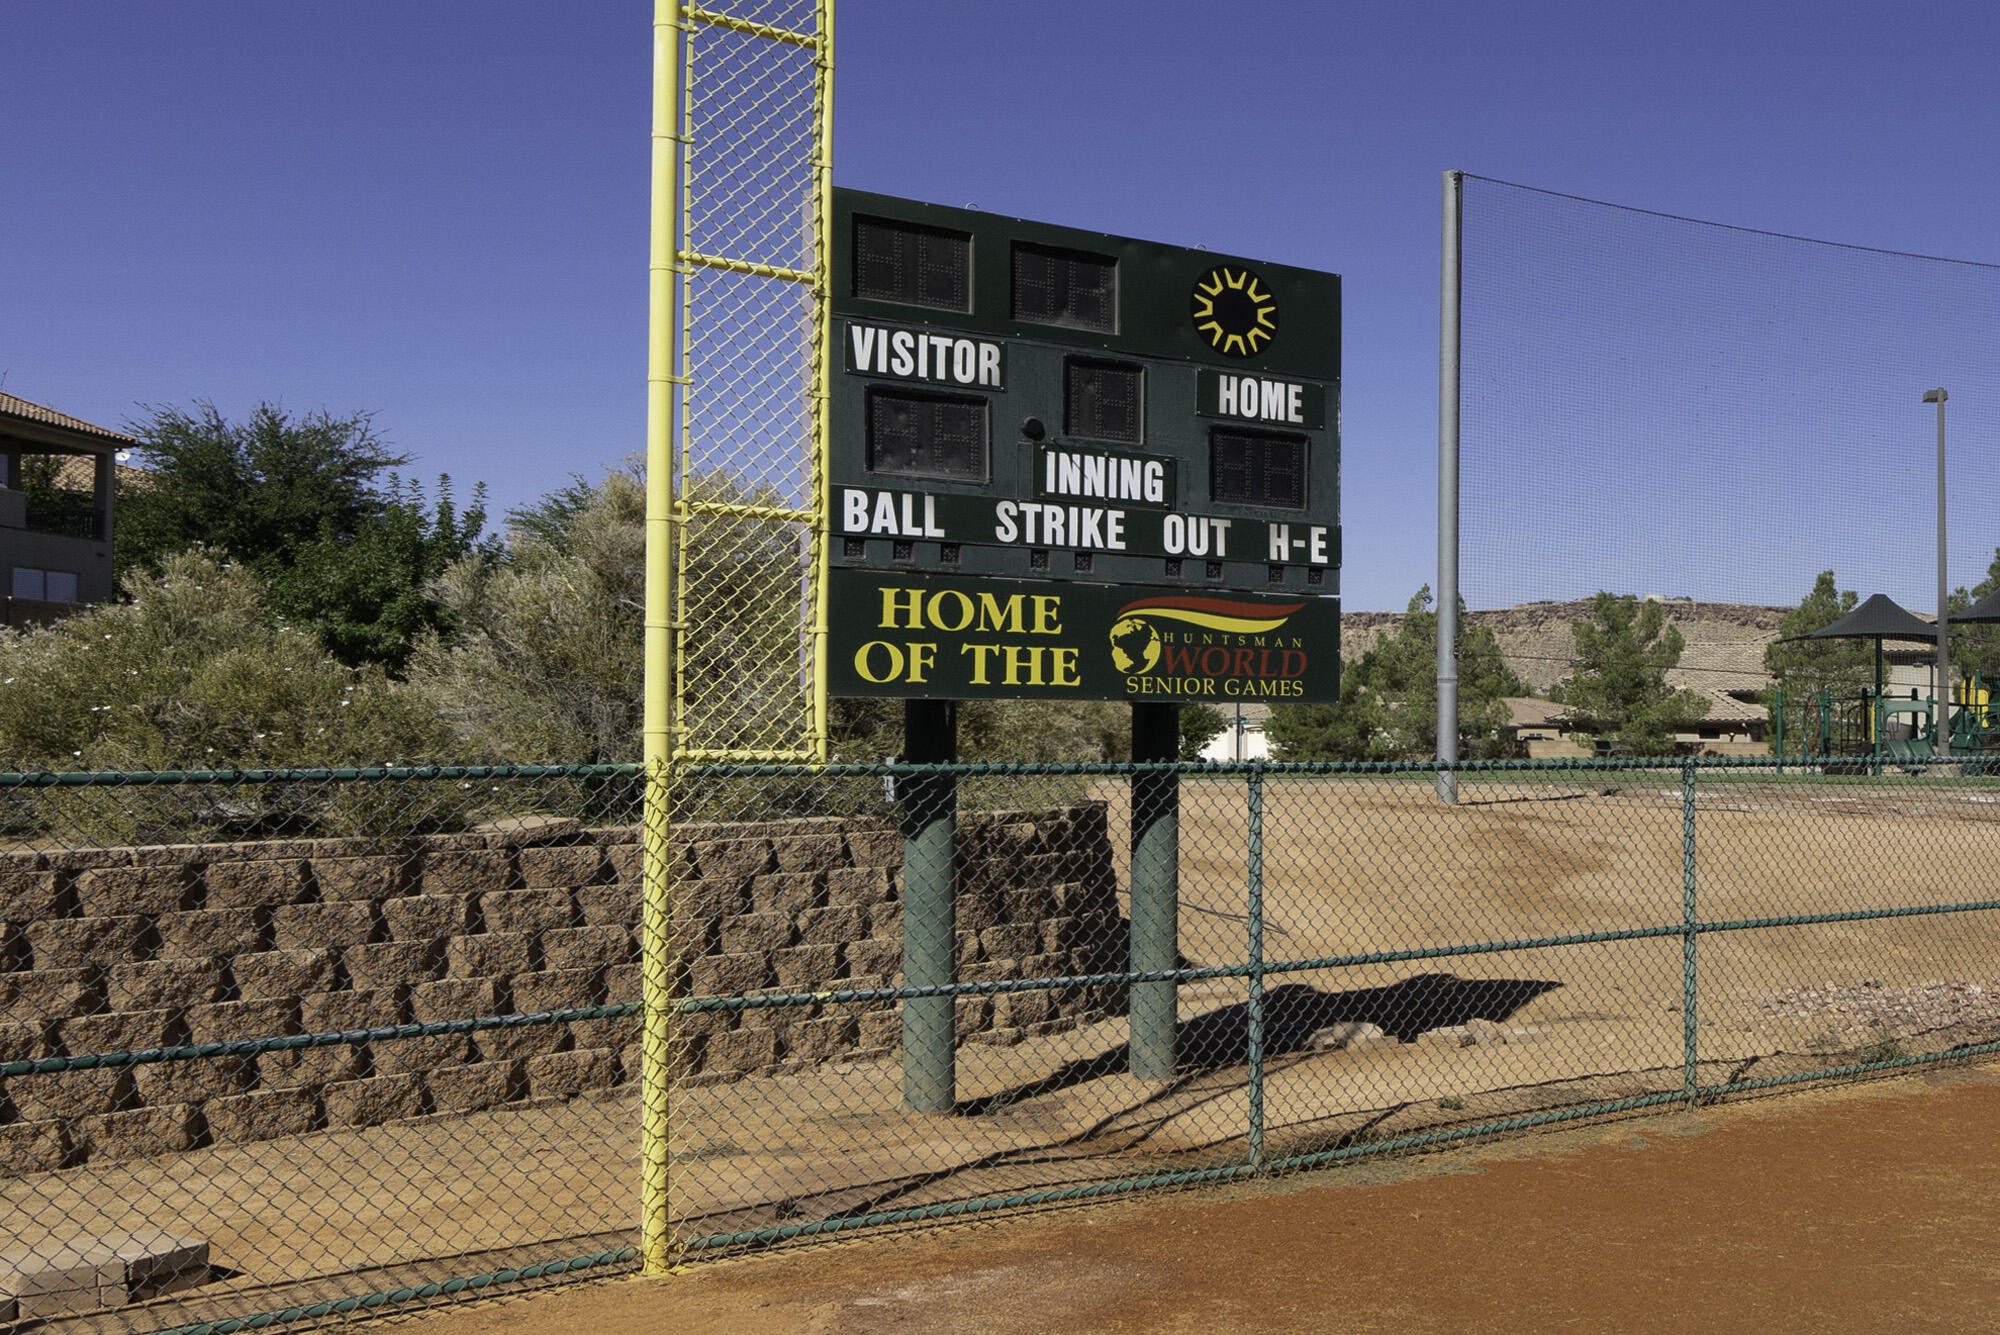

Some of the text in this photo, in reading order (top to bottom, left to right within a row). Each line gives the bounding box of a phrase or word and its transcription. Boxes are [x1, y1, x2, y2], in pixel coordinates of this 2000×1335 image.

[851, 325, 1001, 388] VISITOR
[1218, 374, 1304, 424] HOME
[1045, 451, 1165, 503] INNING
[842, 488, 1329, 564] BALL STRIKE OUT H-E
[877, 587, 1063, 635] HOME
[854, 640, 1081, 687] OF THE
[1163, 646, 1308, 678] WORLD
[1164, 631, 1303, 648] HUNTSMAN
[1126, 676, 1304, 697] SENIOR GAMES
